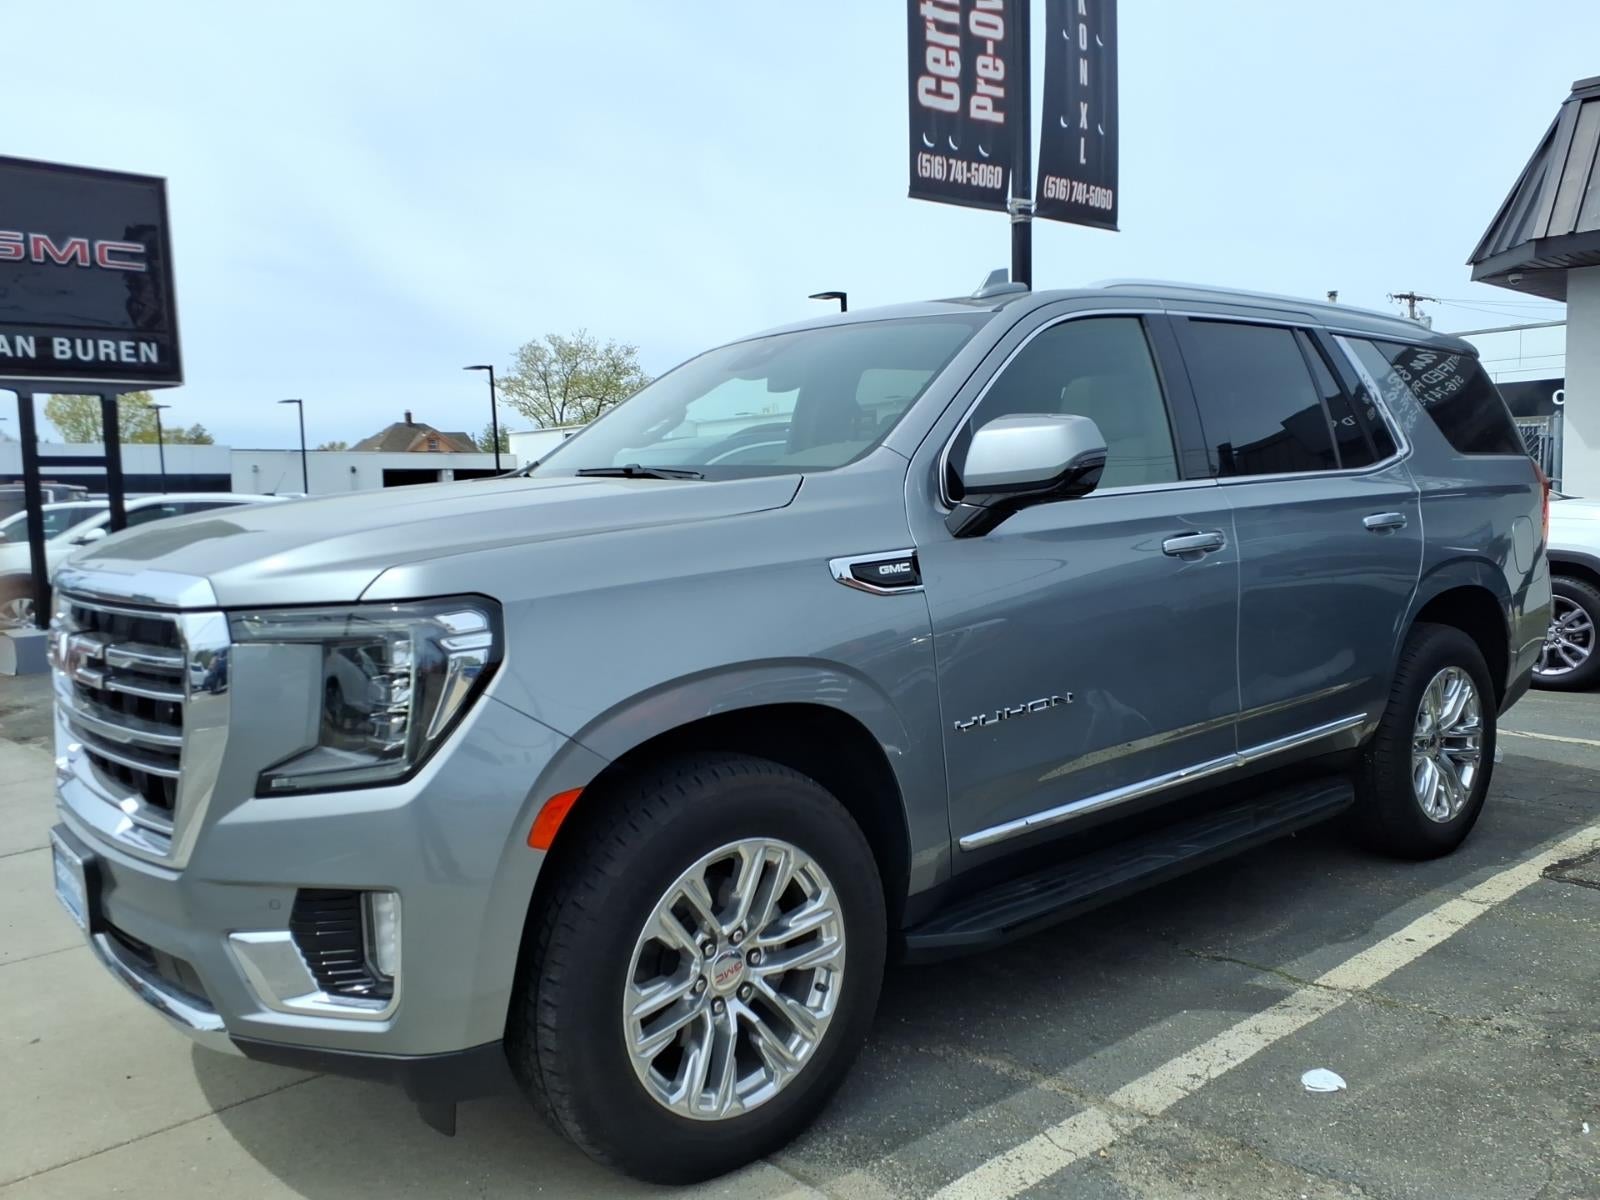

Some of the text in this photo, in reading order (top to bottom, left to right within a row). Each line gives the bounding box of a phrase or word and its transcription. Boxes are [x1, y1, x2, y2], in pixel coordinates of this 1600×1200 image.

[917, 152, 1003, 189] (516) 741-5060
[1043, 175, 1113, 210] (516) 741-5060
[52, 337, 159, 364] BUREN
[879, 562, 911, 575] GMC
